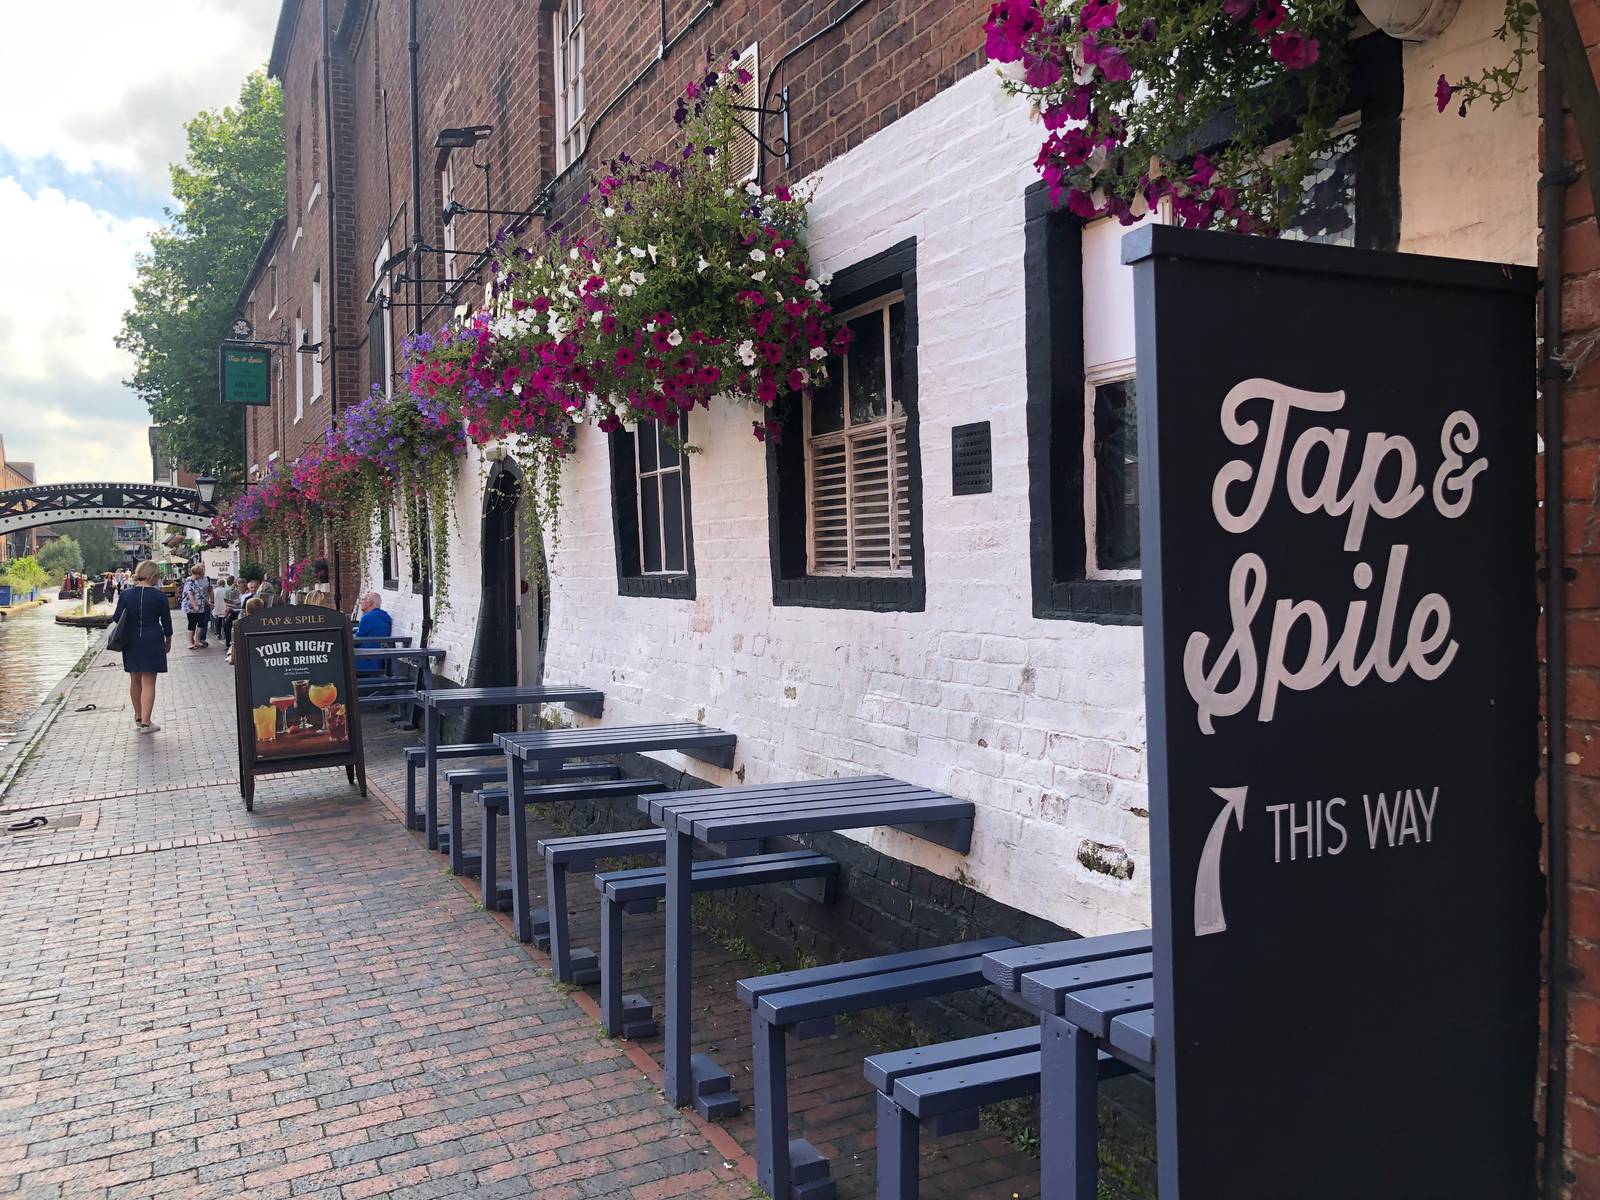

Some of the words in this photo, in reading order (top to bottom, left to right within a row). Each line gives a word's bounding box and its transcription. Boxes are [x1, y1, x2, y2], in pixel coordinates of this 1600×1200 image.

[1211, 377, 1424, 551] Tap
[1432, 410, 1489, 519] &
[260, 617, 281, 626] TAP
[283, 616, 293, 625] &
[295, 614, 325, 624] SPILE
[1183, 543, 1459, 735] Spile
[255, 641, 291, 657] YOUR
[295, 640, 335, 653] NIGHT
[263, 657, 290, 667] YOUR
[293, 654, 329, 665] DRINKS
[1265, 796, 1347, 863] THIS
[1362, 786, 1439, 849] WAY
